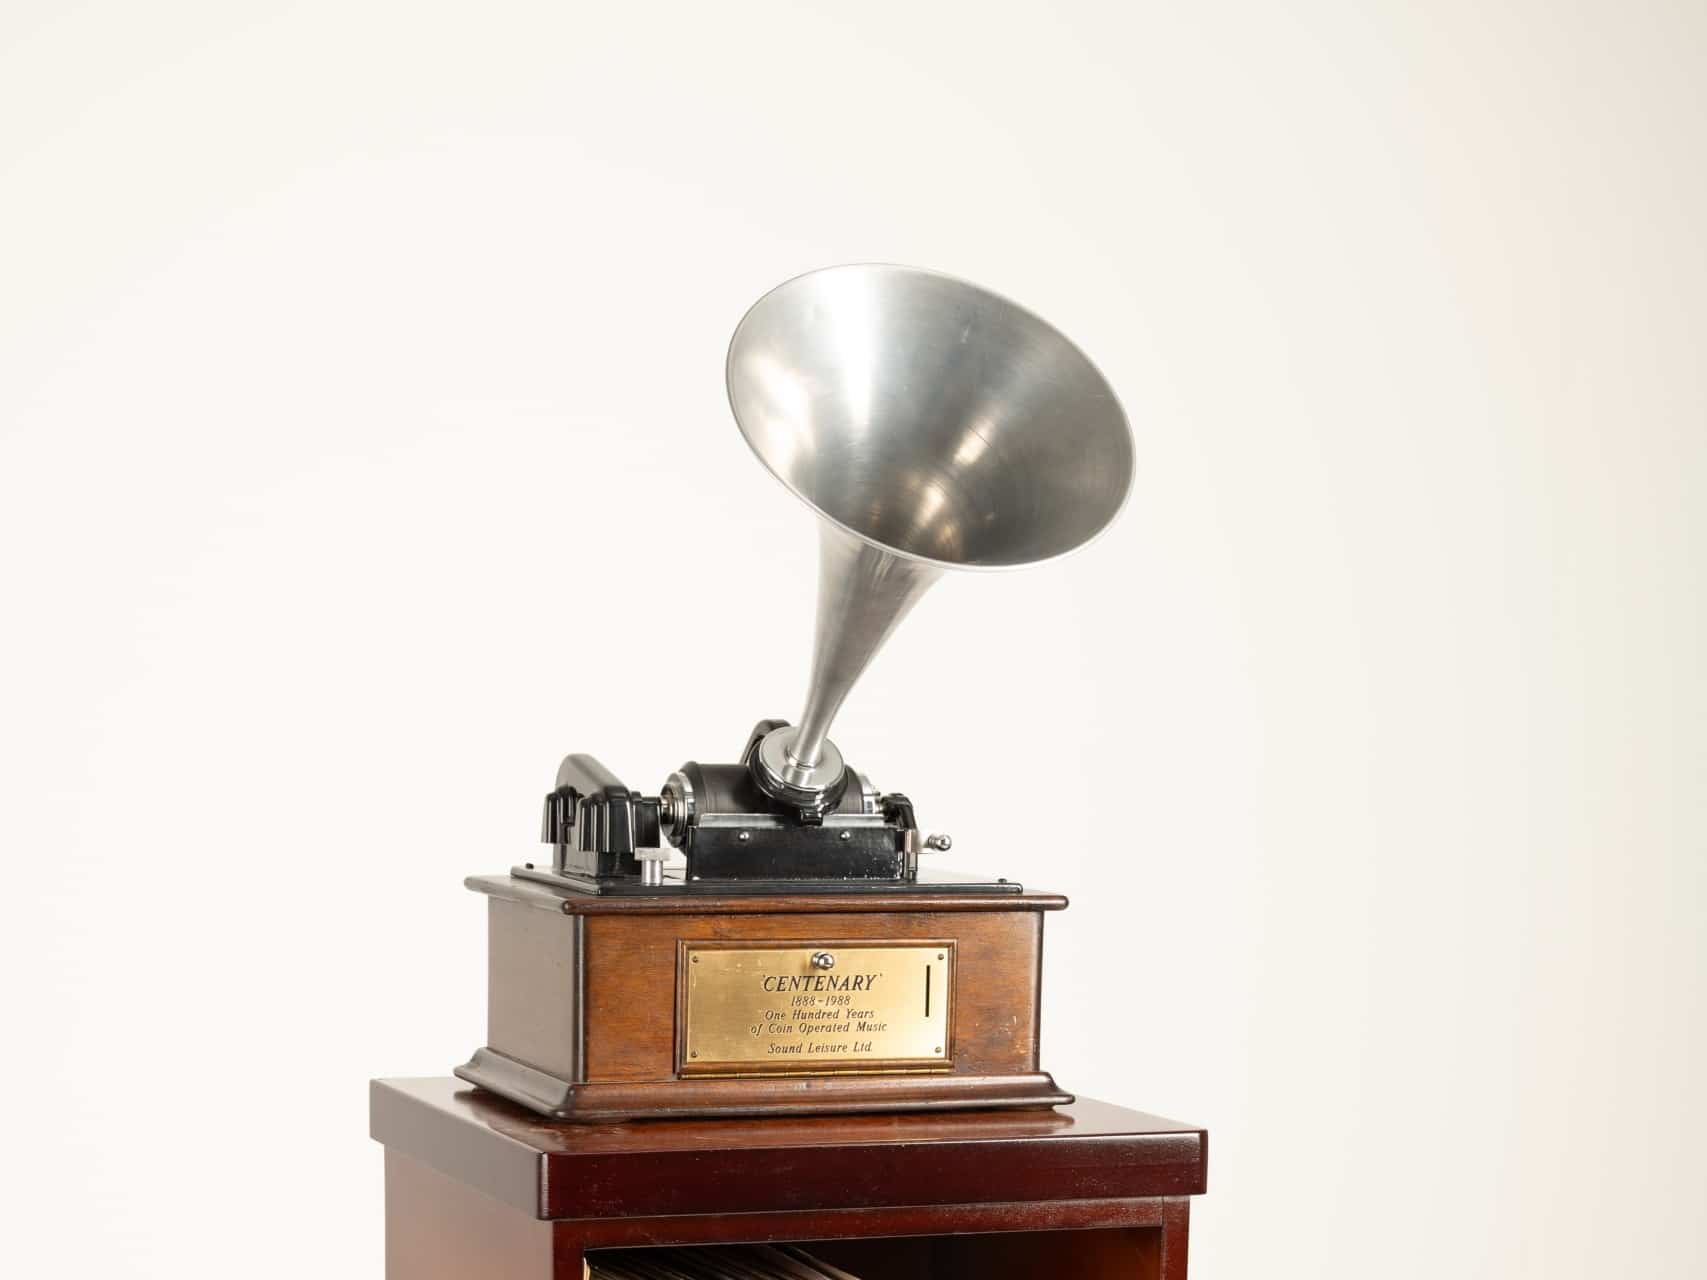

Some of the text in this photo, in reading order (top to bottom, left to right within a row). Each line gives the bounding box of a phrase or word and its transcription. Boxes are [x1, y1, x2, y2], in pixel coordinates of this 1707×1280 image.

[791, 995, 851, 1006] 1888-1988
[765, 1008, 875, 1020] One Hundred Years
[751, 1021, 887, 1036] of Coin Operated Music
[767, 1041, 803, 1054] Sound
[808, 1041, 848, 1053] Leisure
